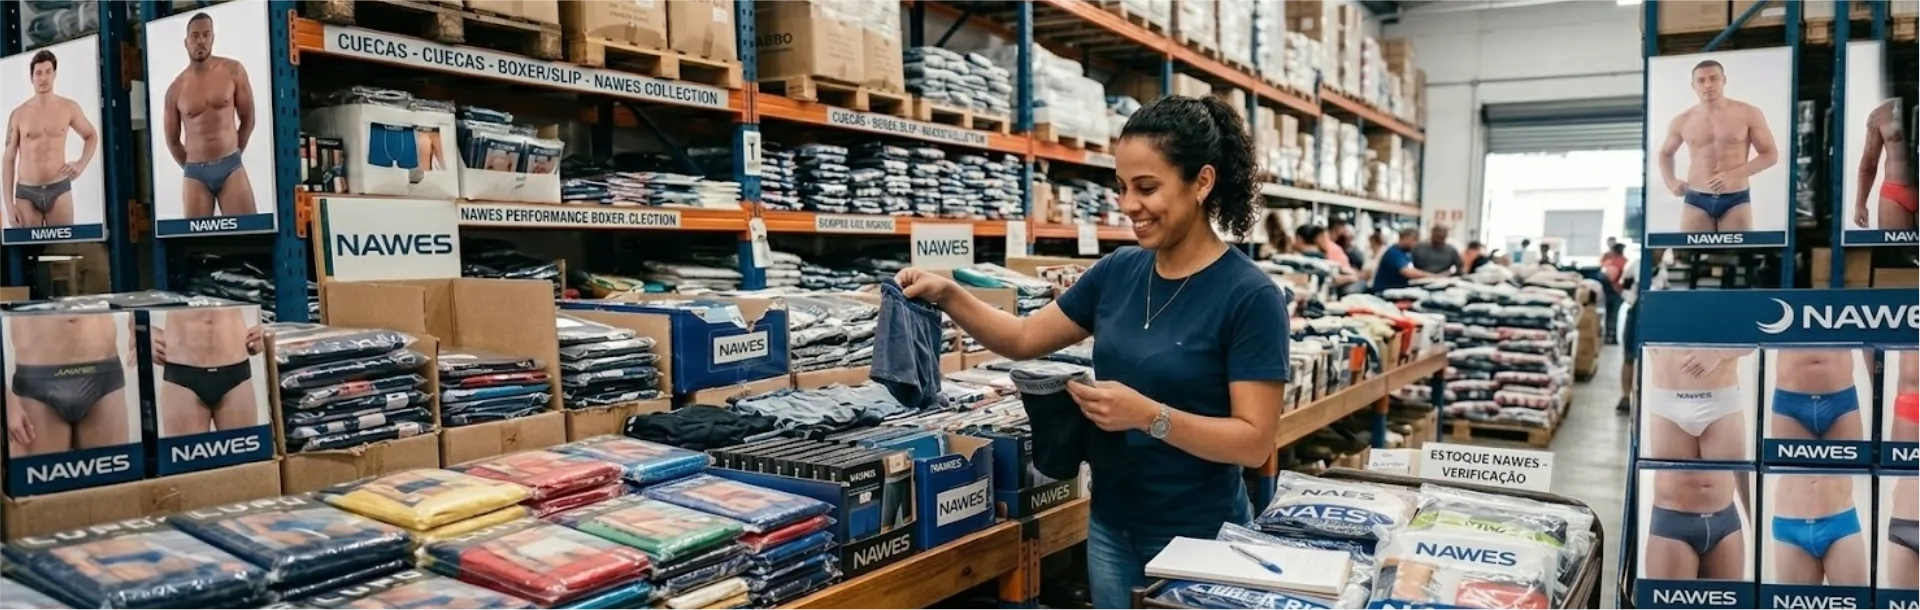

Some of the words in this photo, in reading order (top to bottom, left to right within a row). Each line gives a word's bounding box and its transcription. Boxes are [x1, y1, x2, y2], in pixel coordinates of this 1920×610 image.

[338, 33, 408, 59] CUECAS
[422, 46, 486, 71] CUECAS
[498, 59, 582, 85] BOXER/SLIP
[594, 74, 642, 95] NAWES
[645, 82, 718, 105] COLLECTION
[461, 207, 503, 222] NAWES
[506, 209, 589, 224] PERFORMANCE
[31, 227, 73, 240] NAWES
[190, 218, 238, 232] NAWES
[336, 234, 453, 256] NAWES
[1687, 233, 1744, 244] NAWES
[916, 239, 970, 257] NAWES
[719, 339, 765, 356] NAWES
[171, 435, 260, 463] NAWES
[1777, 445, 1858, 459] NAWES
[1430, 449, 1489, 464] ESTOQUE
[1492, 454, 1540, 468] NAWES
[27, 454, 131, 484] NAWES
[1442, 466, 1526, 484] VERIFICAÇÃO
[939, 489, 985, 517] NAWES
[1030, 483, 1070, 510] NAWES
[853, 533, 910, 570] NAWES
[1415, 542, 1517, 567] NAWES
[1653, 588, 1737, 606] NAWES
[1772, 595, 1857, 610] NAWES
